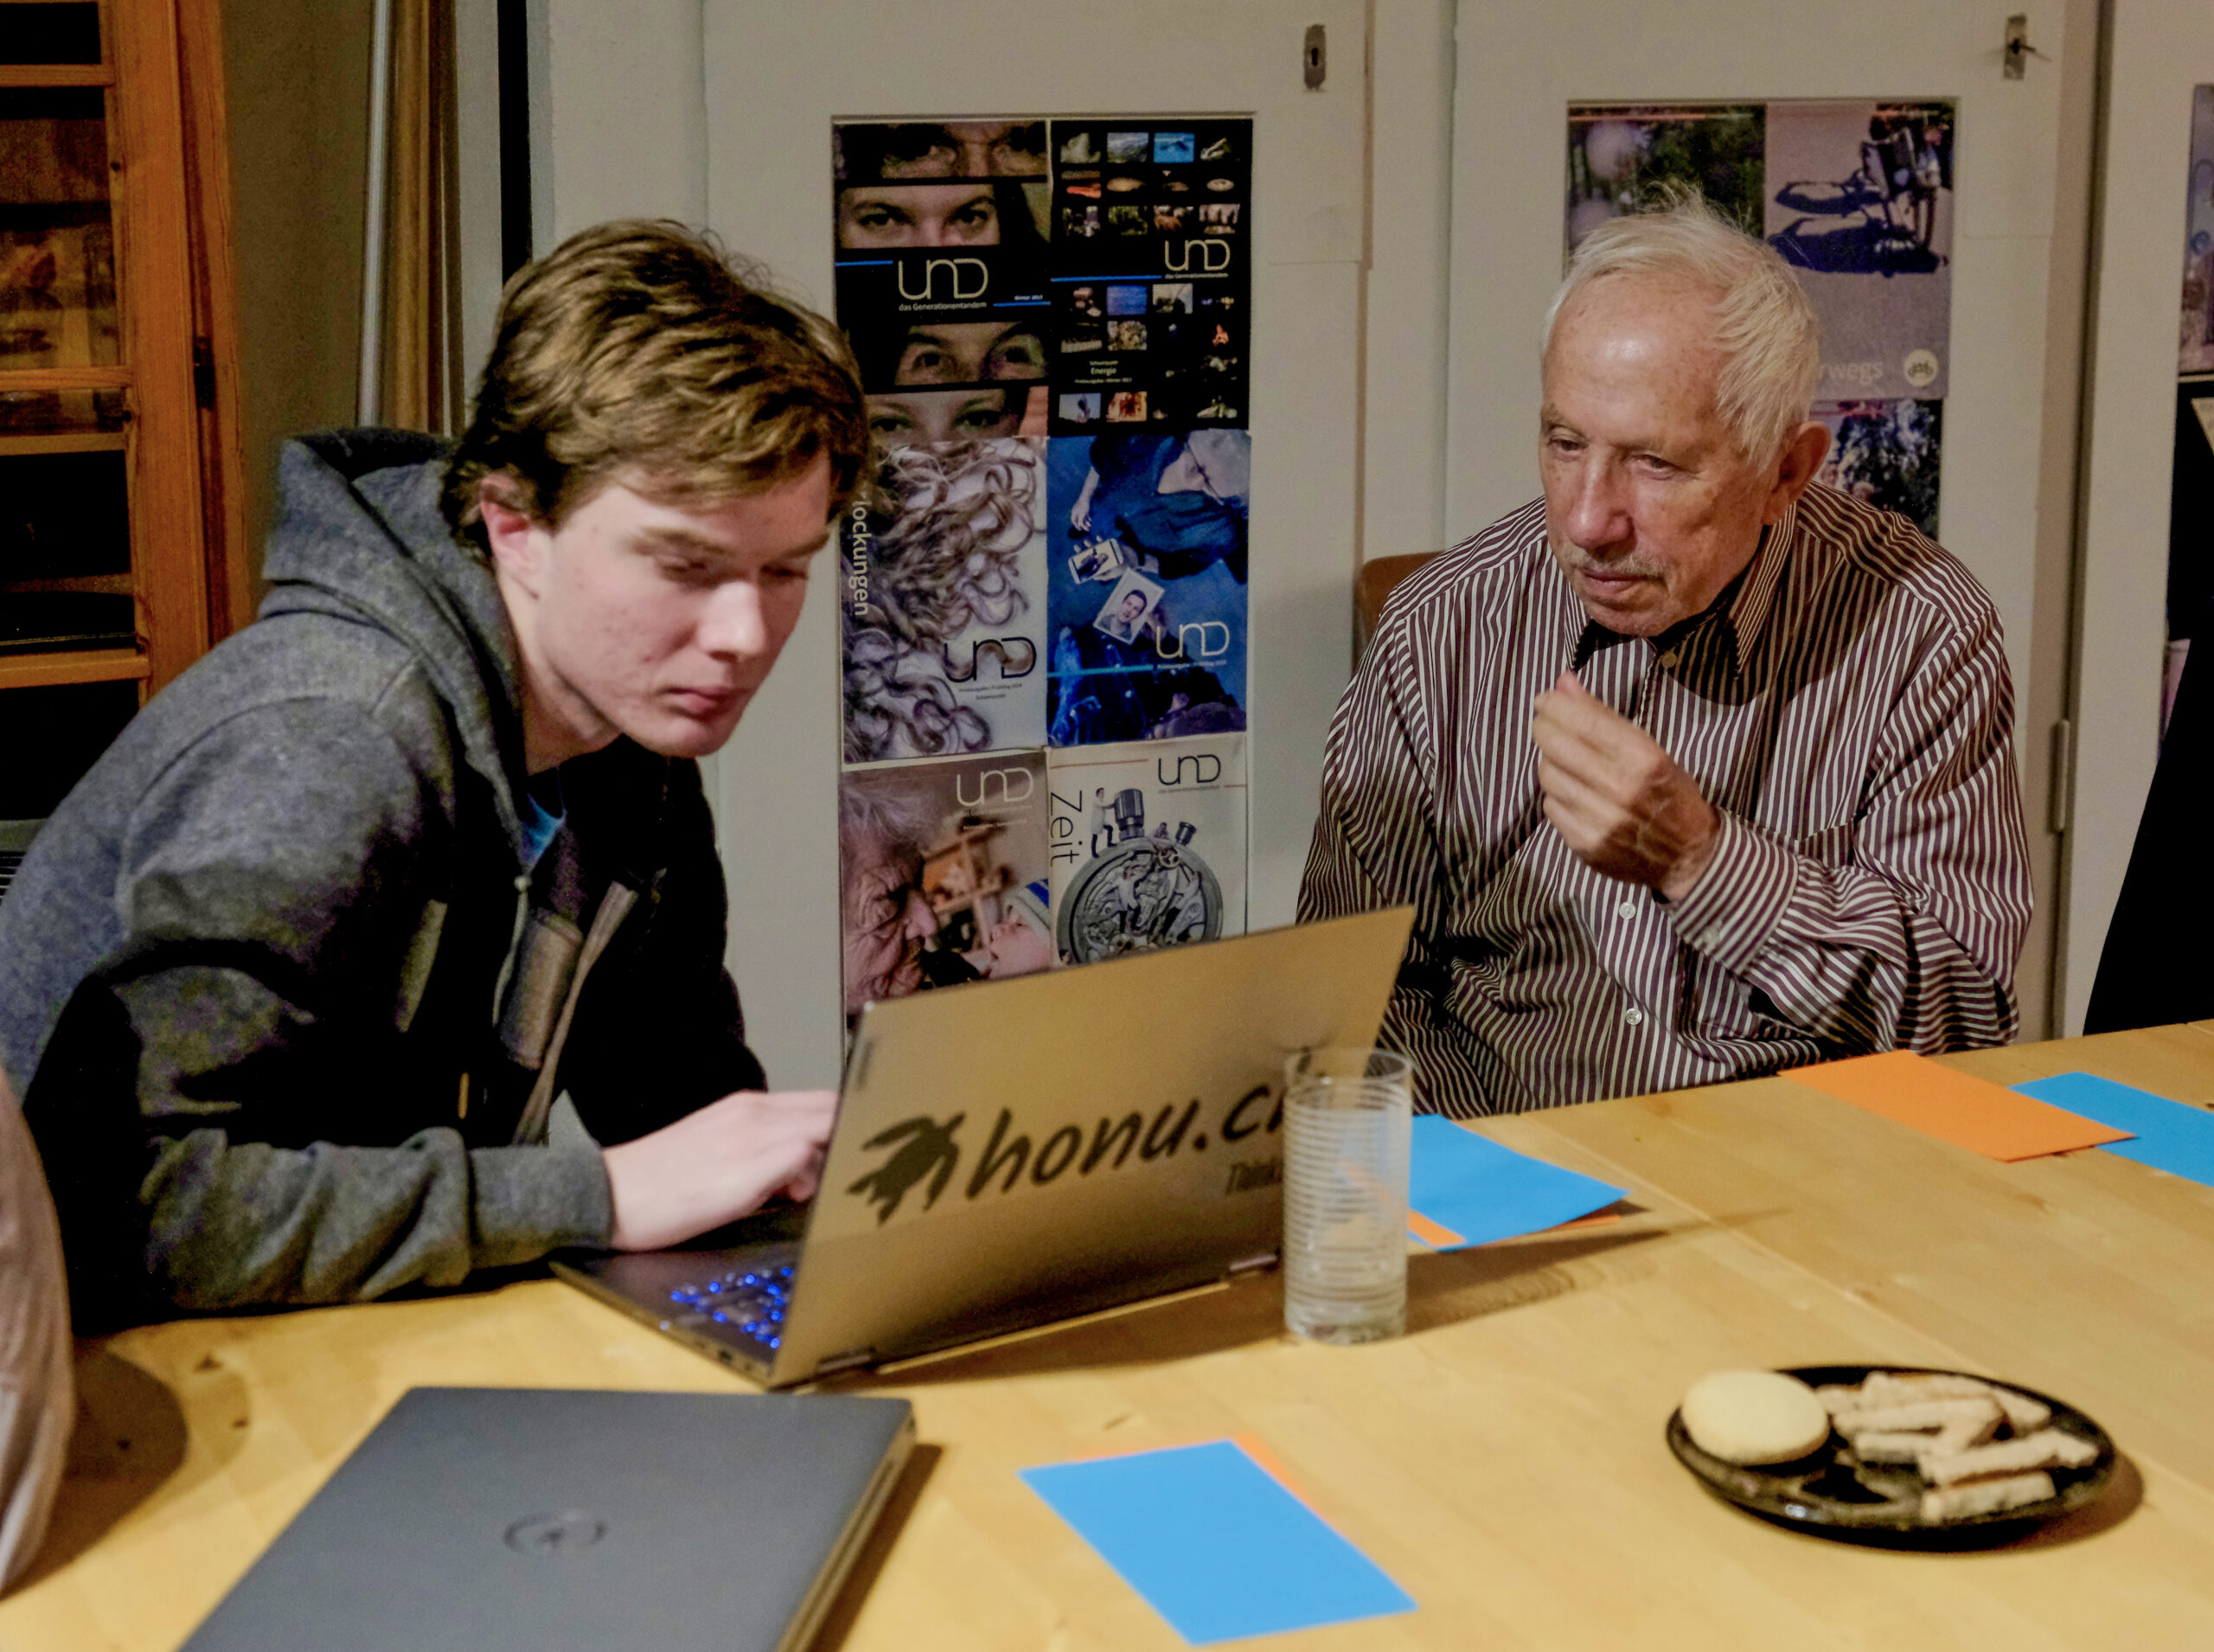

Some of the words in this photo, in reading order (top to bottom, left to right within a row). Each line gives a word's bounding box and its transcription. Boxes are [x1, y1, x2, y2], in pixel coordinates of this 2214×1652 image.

[912, 302, 987, 311] Generationentandem
[1091, 367, 1117, 376] Energie
[1819, 362, 1884, 386] rwegs
[848, 501, 872, 616] lockungen
[1050, 790, 1082, 867] Zeit
